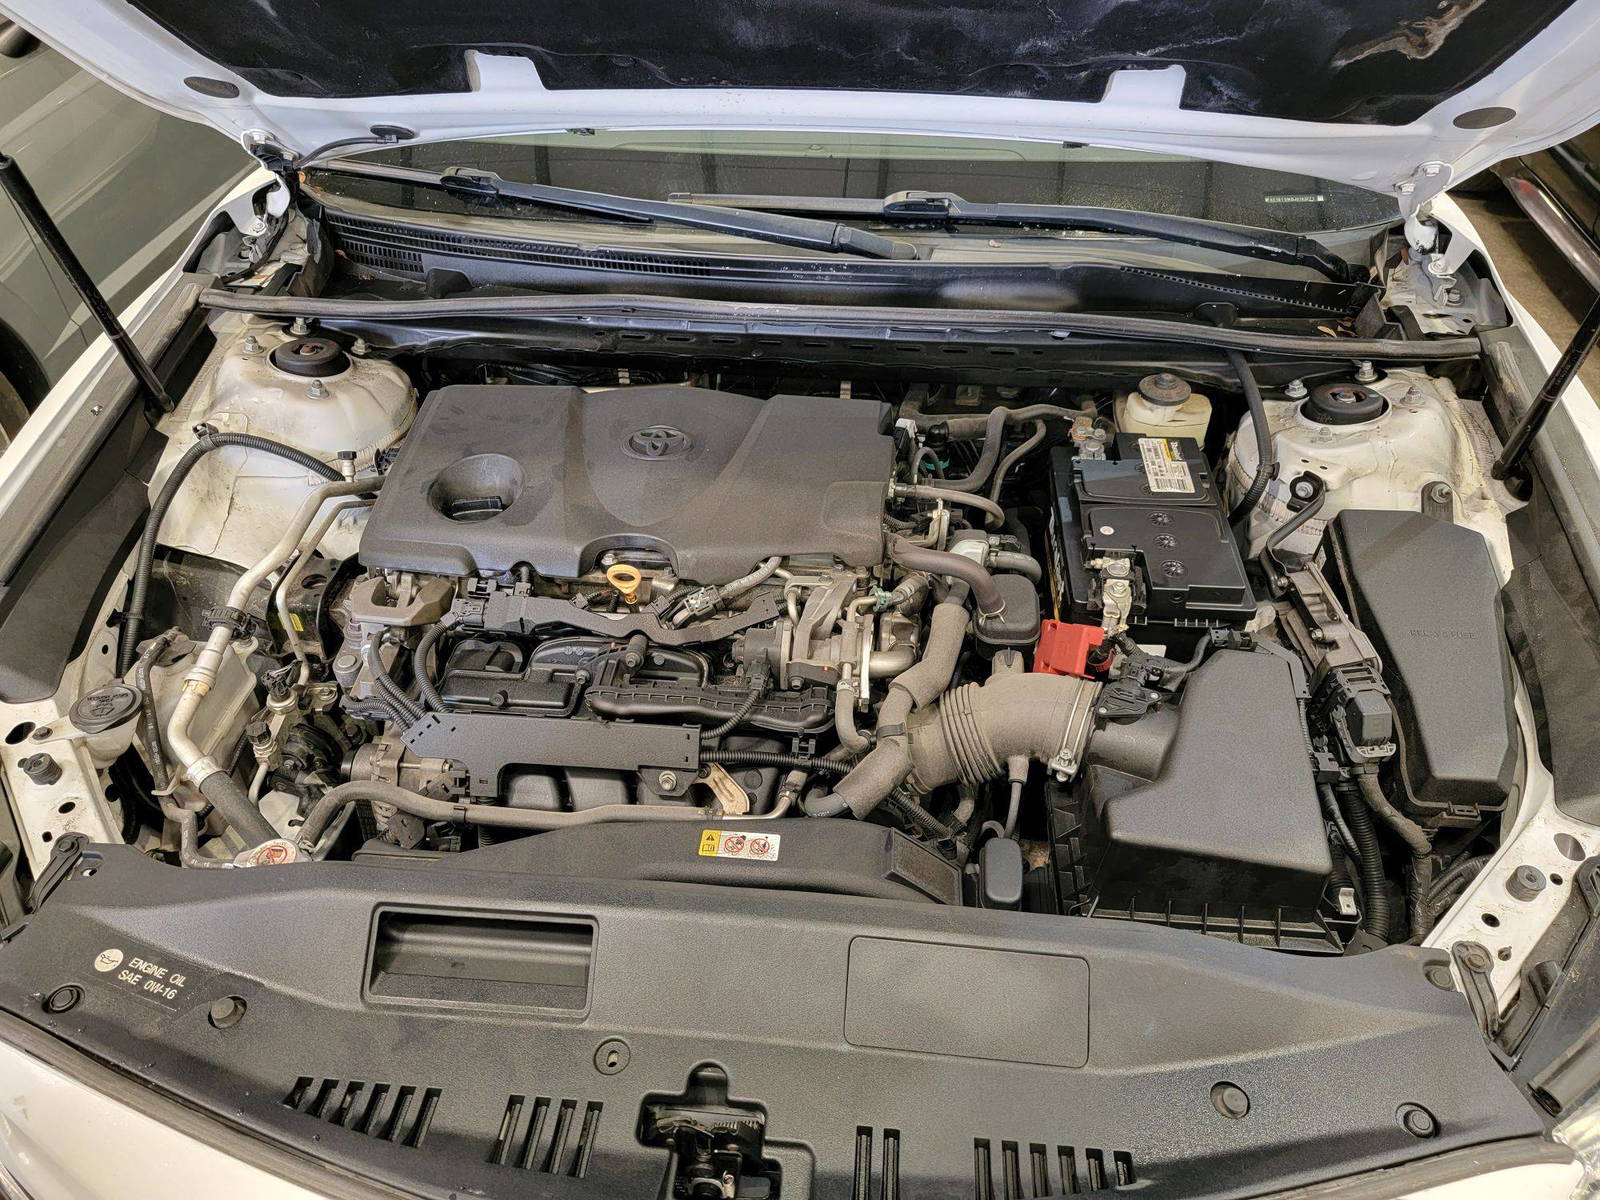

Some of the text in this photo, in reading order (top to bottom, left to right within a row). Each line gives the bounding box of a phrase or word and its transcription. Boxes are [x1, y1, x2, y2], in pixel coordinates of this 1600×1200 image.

[118, 969, 178, 1000] SAE 0W-16
[128, 957, 186, 988] ENGINE OIL
